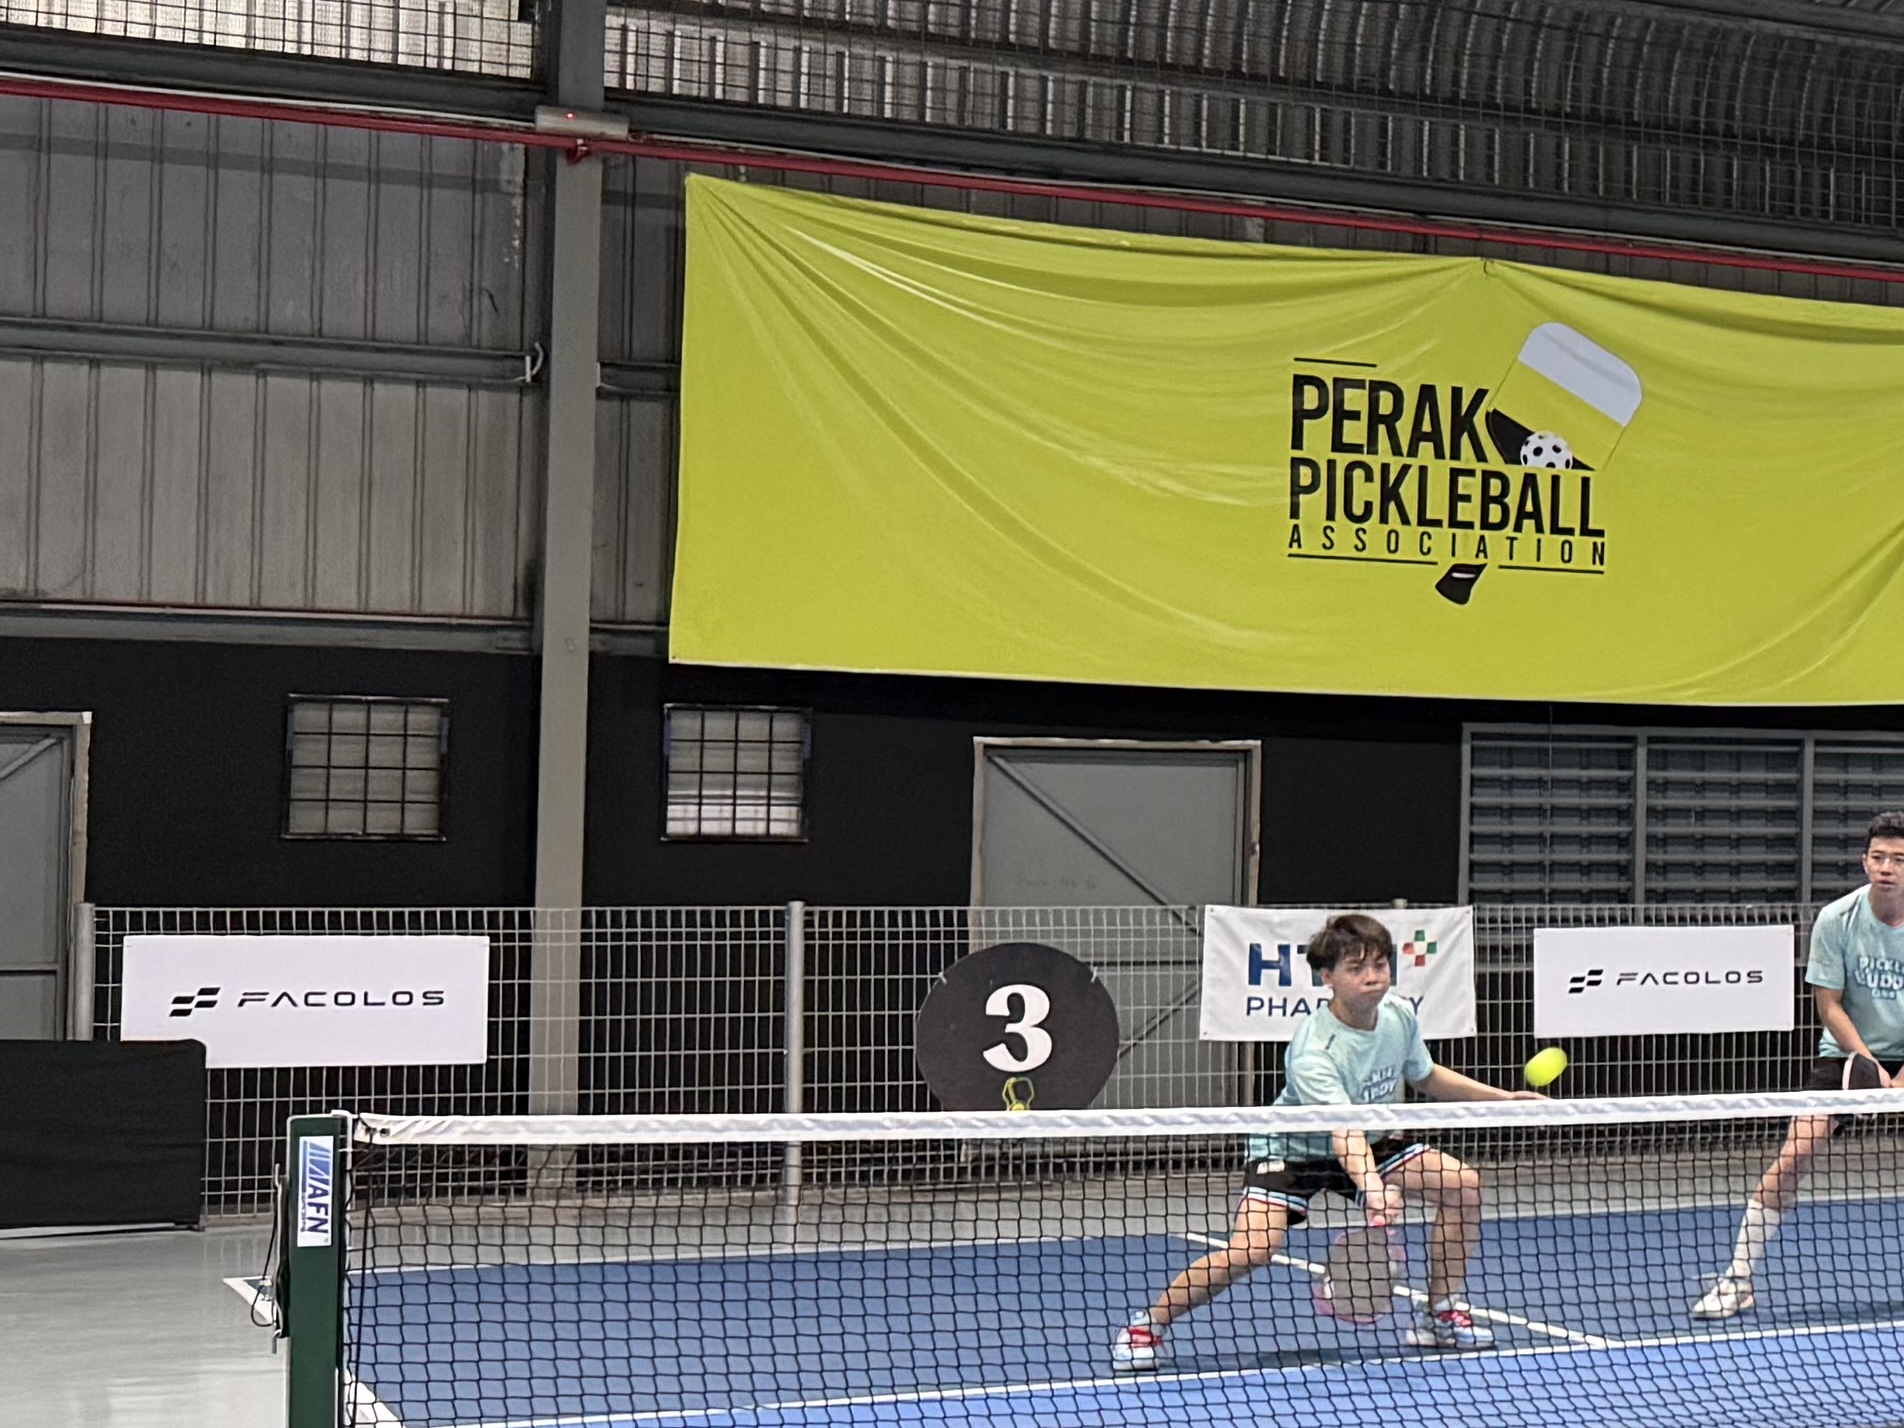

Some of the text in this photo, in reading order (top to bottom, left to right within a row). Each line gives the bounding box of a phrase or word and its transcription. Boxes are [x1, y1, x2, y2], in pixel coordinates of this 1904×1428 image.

[1290, 374, 1489, 463] PERAK
[1289, 456, 1606, 538] PICKLEBALL
[1288, 524, 1605, 566] ASSOCIATION
[238, 988, 446, 1008] FACOLOS
[1617, 970, 1763, 986] FACOLOS
[982, 983, 1053, 1073] 3
